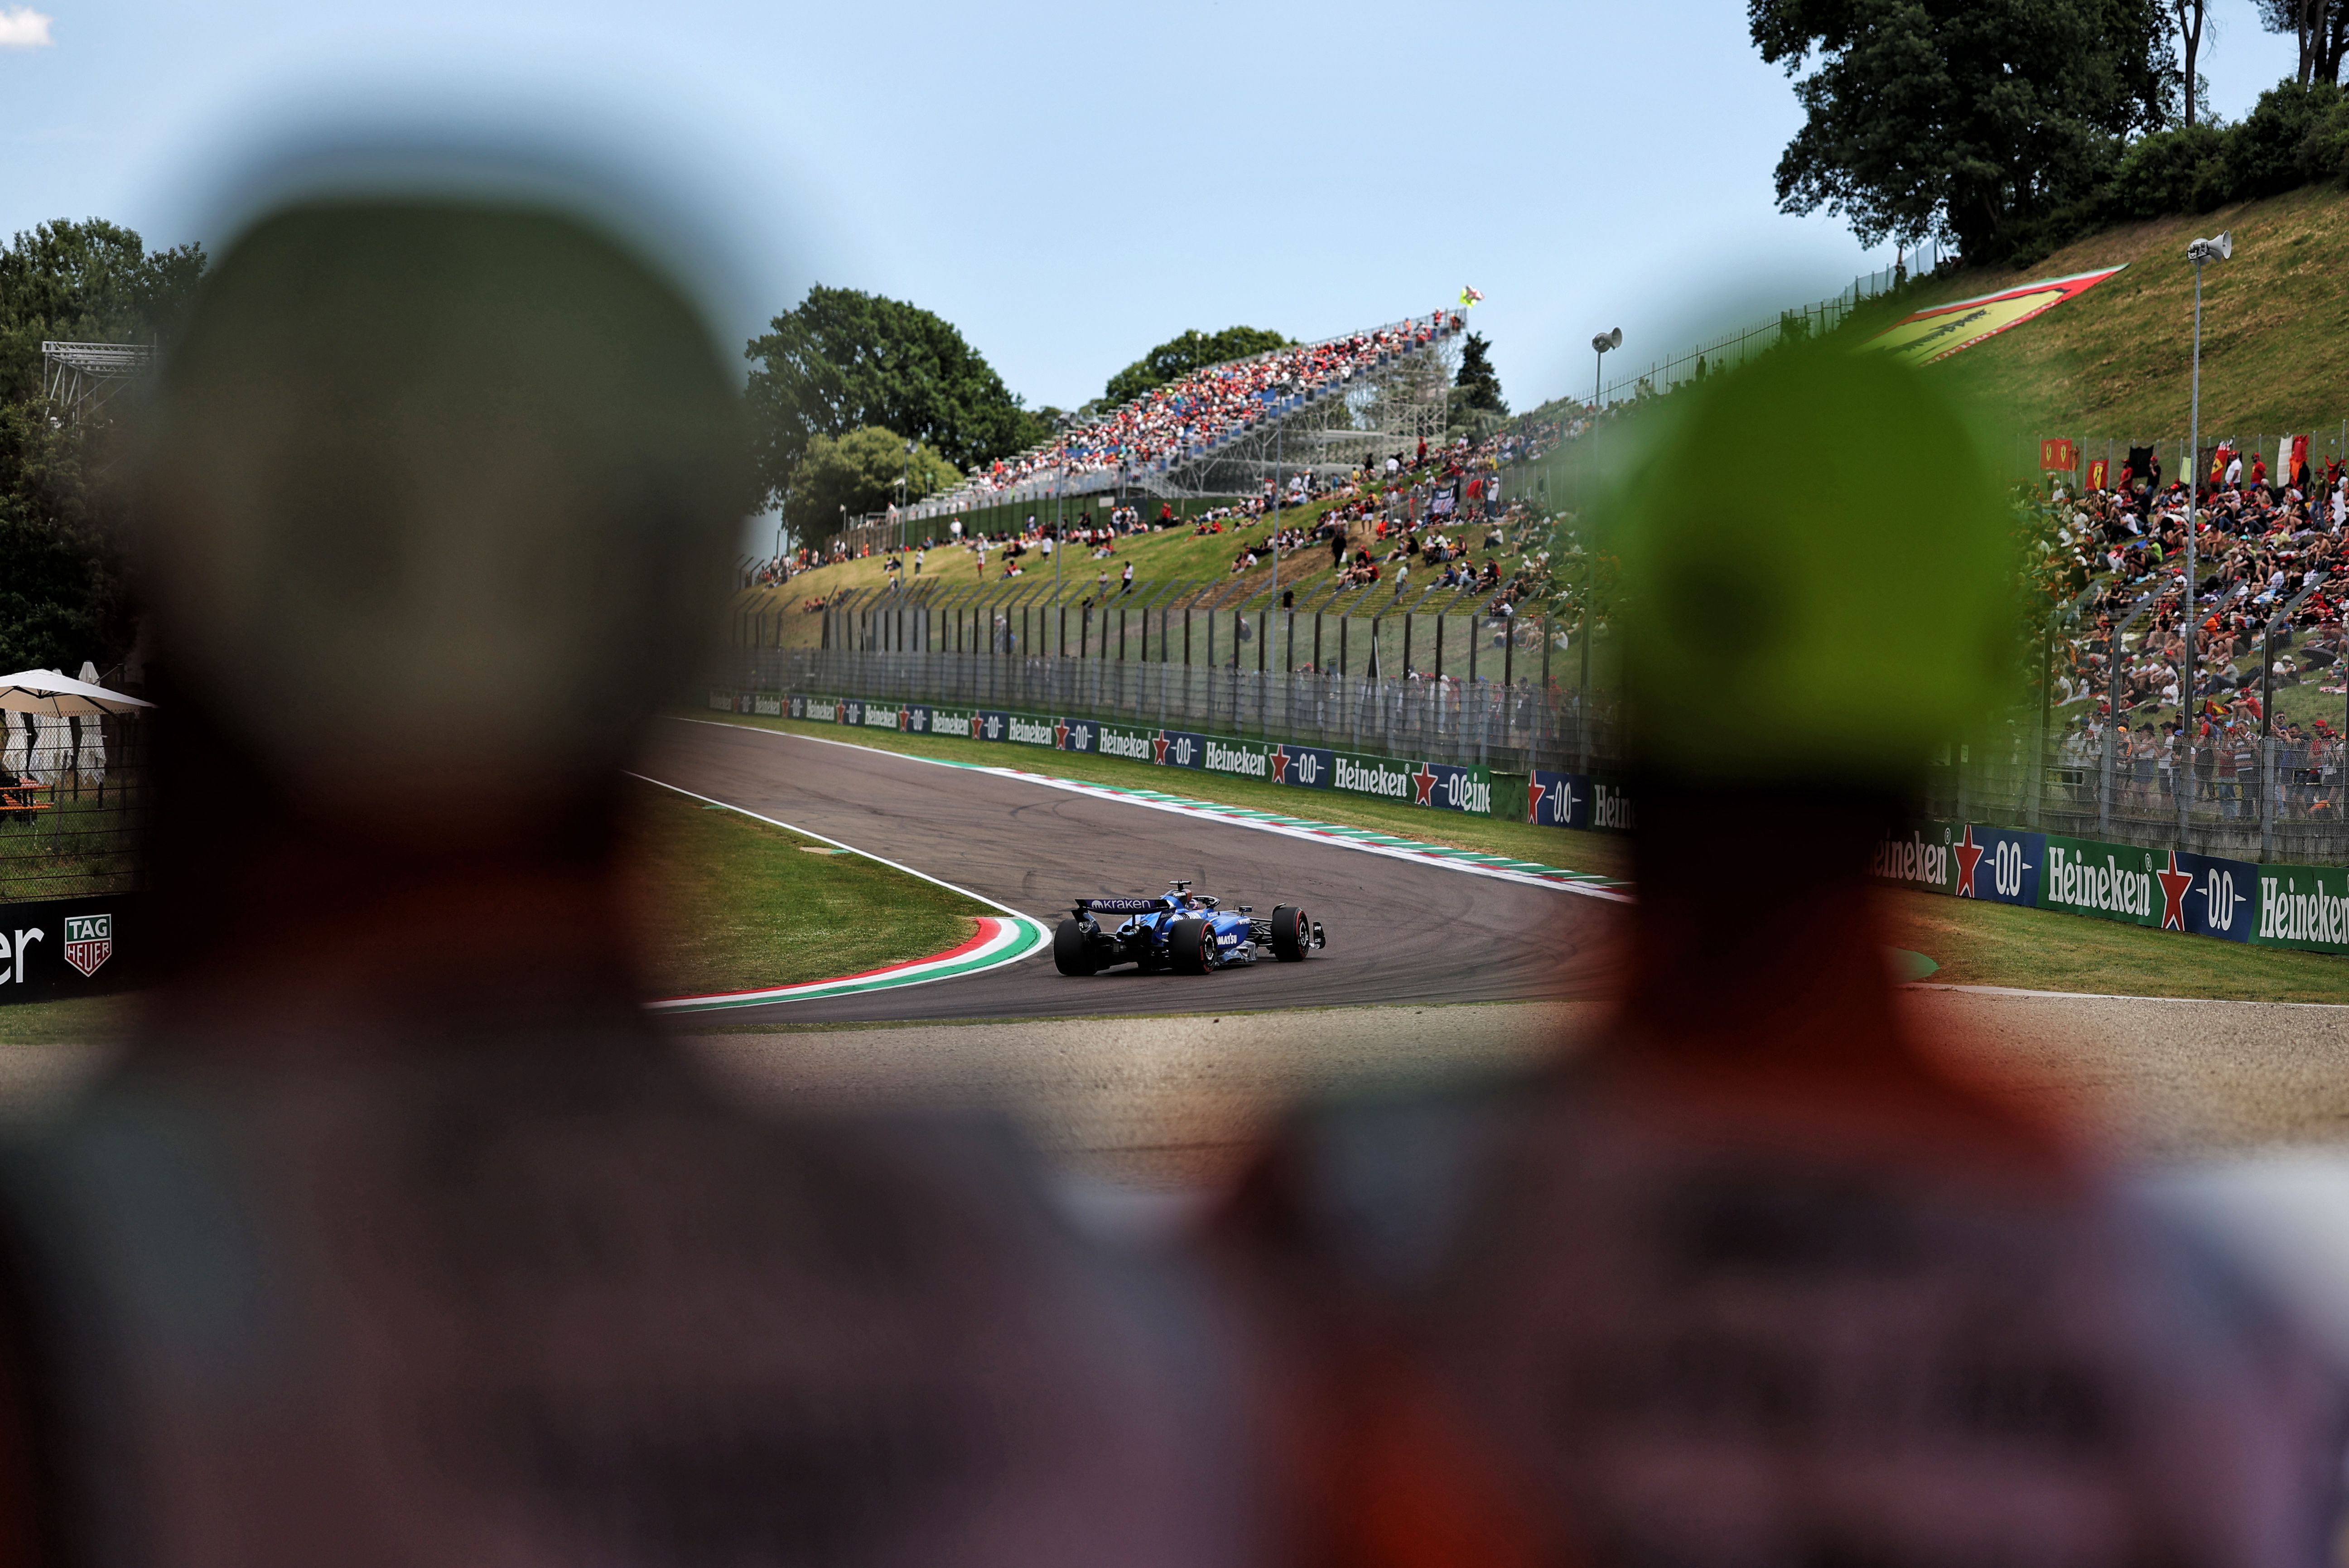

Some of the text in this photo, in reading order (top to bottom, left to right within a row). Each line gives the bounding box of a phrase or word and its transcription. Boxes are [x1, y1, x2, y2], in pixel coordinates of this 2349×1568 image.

[806, 699, 834, 721] Heineken
[864, 704, 897, 728] Heineken
[931, 710, 969, 735] Heineken
[1008, 717, 1052, 745] Heineken
[1099, 727, 1149, 759] Heineken
[1205, 742, 1317, 784] Heineken 0.0
[1334, 758, 1407, 797] Heineken
[1553, 781, 1638, 830] 0.0 Hein
[1869, 826, 2021, 897] eineken 0.0
[2048, 847, 2233, 931] Heineken 0.0
[1104, 900, 1151, 909] kraken
[2259, 877, 2349, 944] Heineken
[69, 918, 107, 939] TAG
[1217, 933, 1237, 945] MATSU
[68, 942, 109, 972] HEUER
